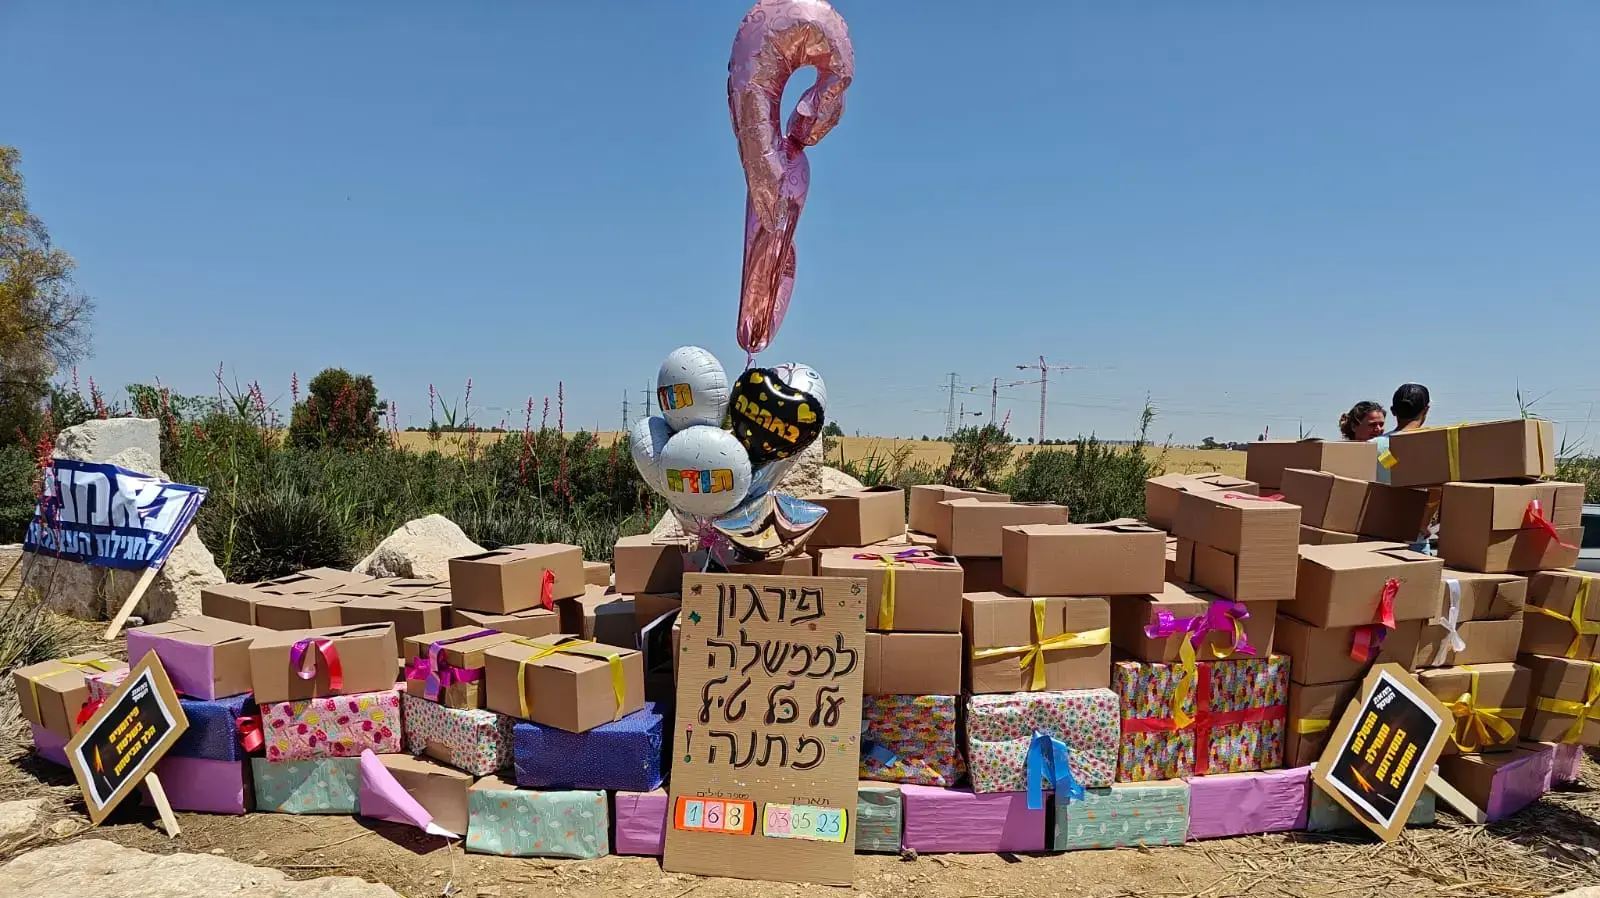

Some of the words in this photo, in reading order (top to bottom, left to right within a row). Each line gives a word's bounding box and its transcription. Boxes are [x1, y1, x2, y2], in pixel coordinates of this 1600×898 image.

[657, 383, 693, 411] תוד
[734, 394, 800, 444] באהבה
[35, 466, 191, 535] נאמני
[666, 468, 735, 494] תודה
[95, 530, 163, 561] למגילת
[716, 582, 826, 638] פירגון
[706, 628, 858, 680] לממשלה
[698, 675, 752, 725] טיל
[763, 680, 799, 726] כל
[809, 685, 847, 728] על
[1390, 742, 1418, 789] הממשלה
[696, 787, 724, 798] טילים
